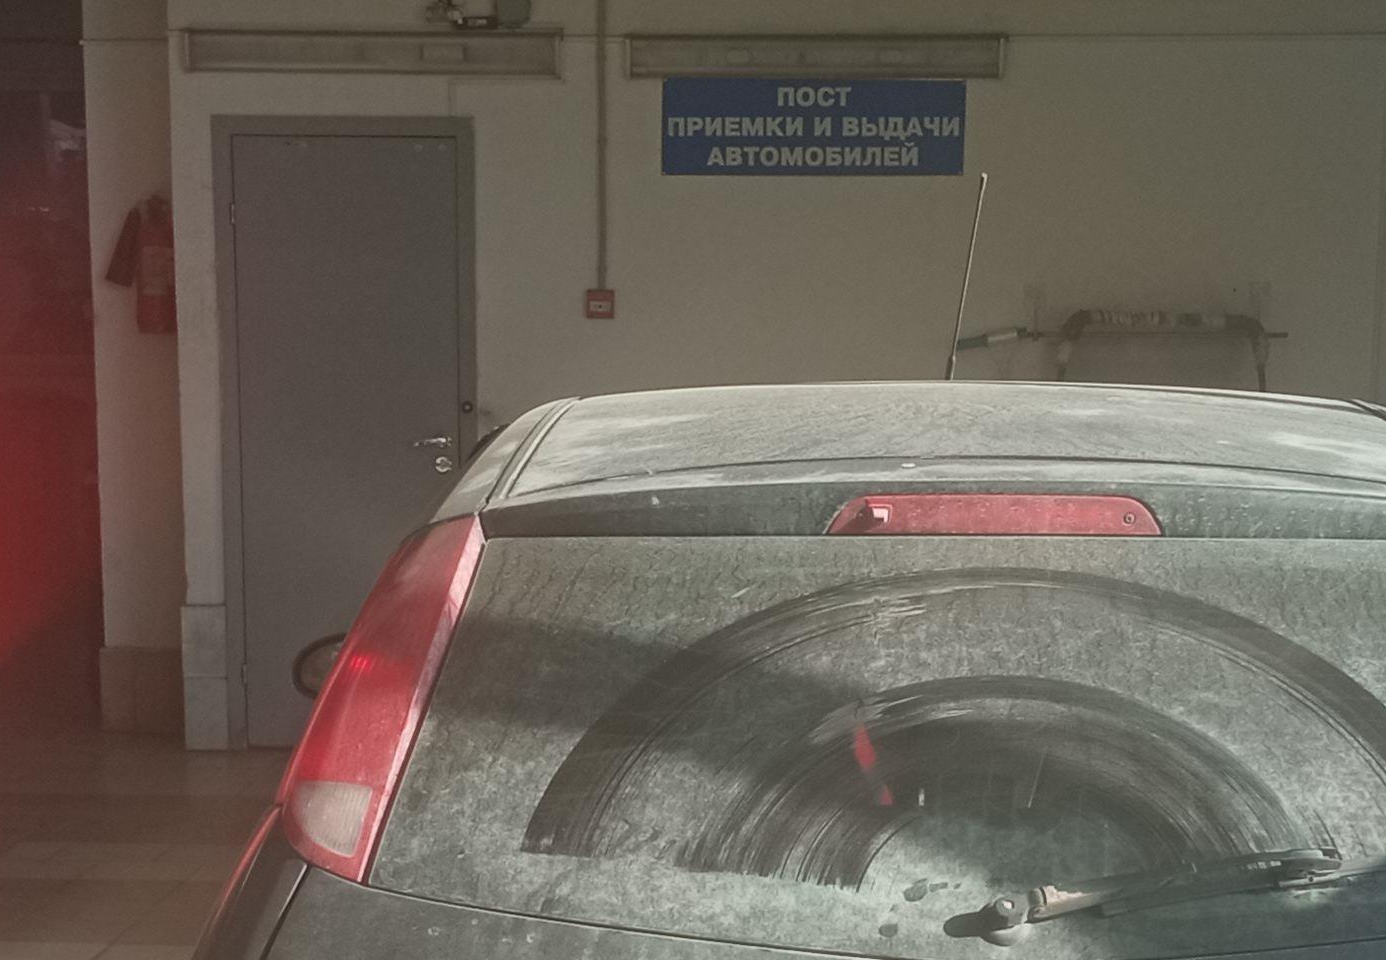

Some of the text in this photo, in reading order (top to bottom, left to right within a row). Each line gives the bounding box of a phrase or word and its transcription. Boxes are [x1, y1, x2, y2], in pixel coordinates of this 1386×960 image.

[777, 86, 852, 107] ПОСТ
[668, 116, 960, 141] ПРИЕМКИ И ВЫДАЧИ
[707, 142, 919, 167] АВТОМОБИЛЕЙ
